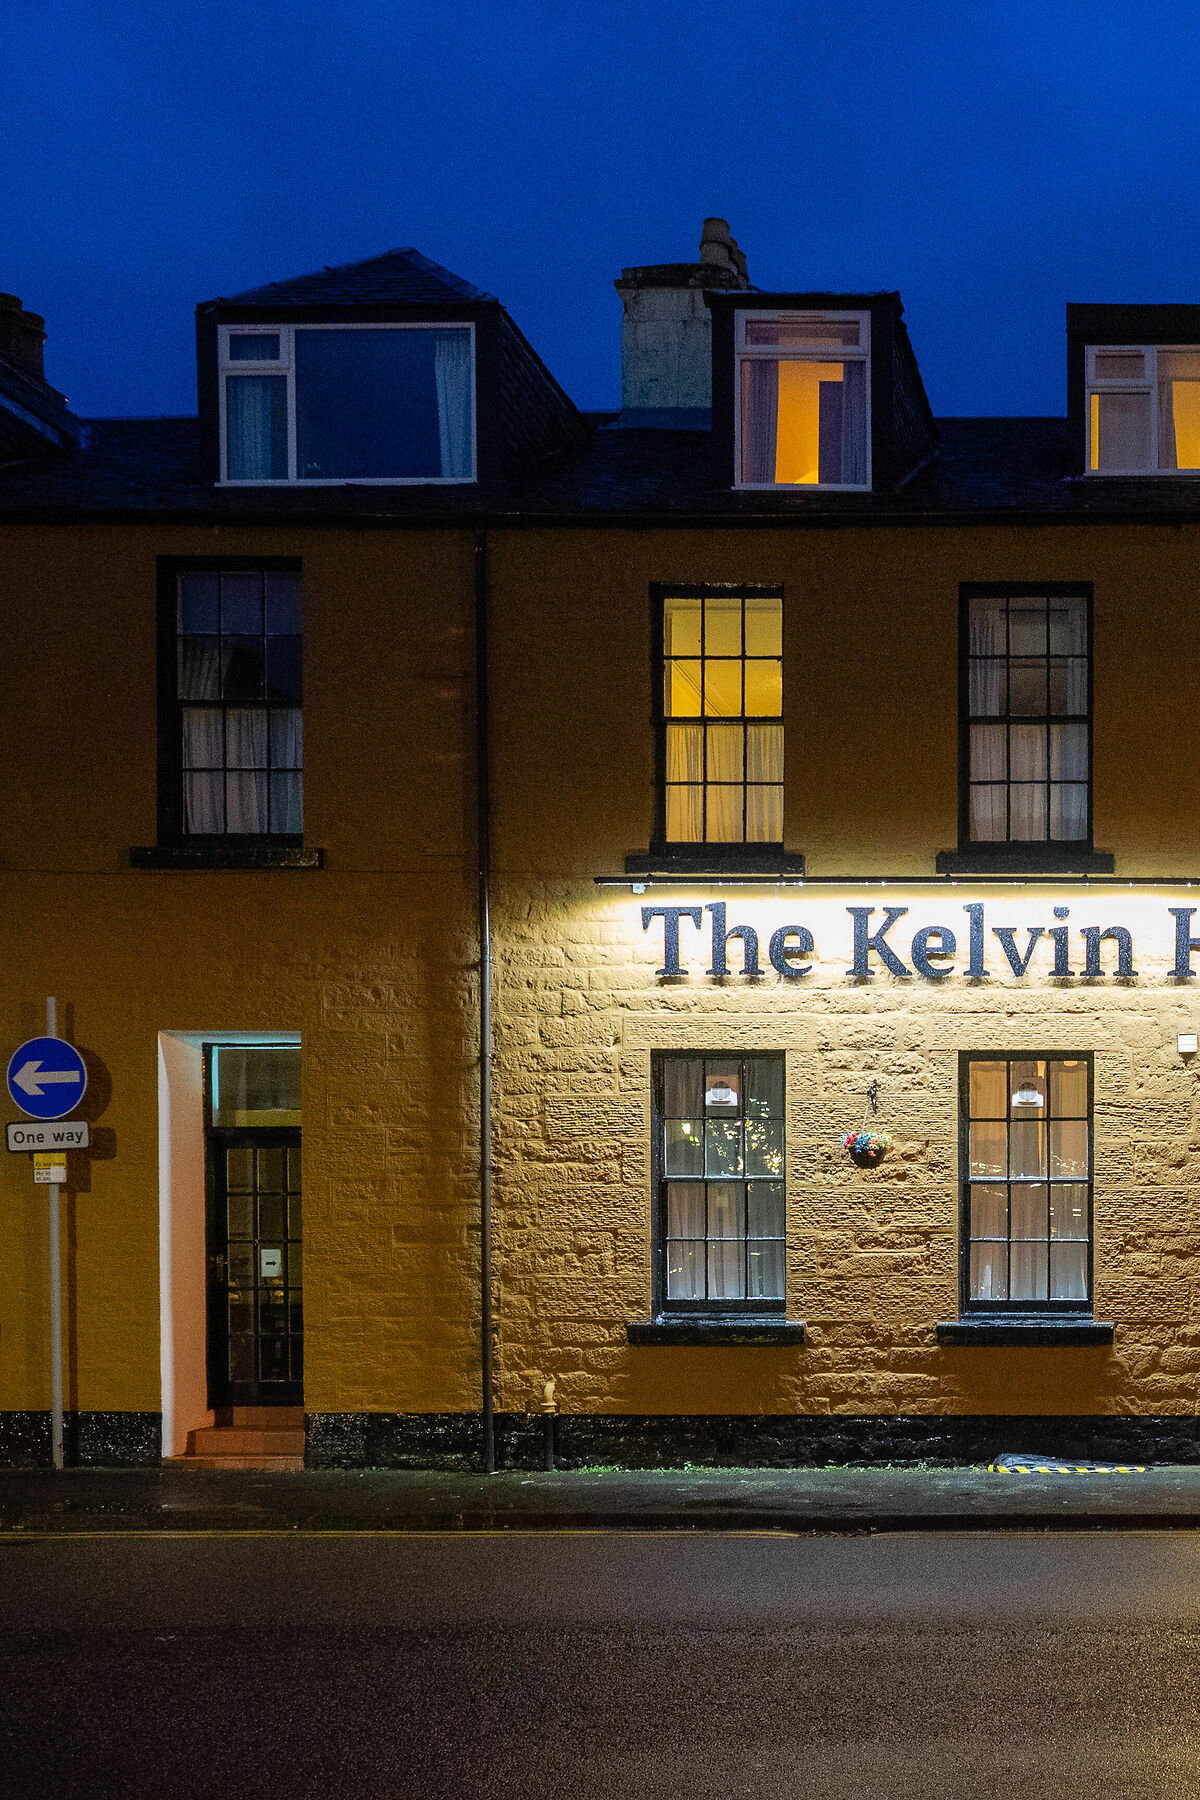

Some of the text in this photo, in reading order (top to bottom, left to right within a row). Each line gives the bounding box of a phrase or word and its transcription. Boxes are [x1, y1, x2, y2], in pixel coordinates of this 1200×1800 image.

[641, 902, 815, 977] The
[845, 902, 1139, 978] Kelvin
[13, 1131, 84, 1144] One way
